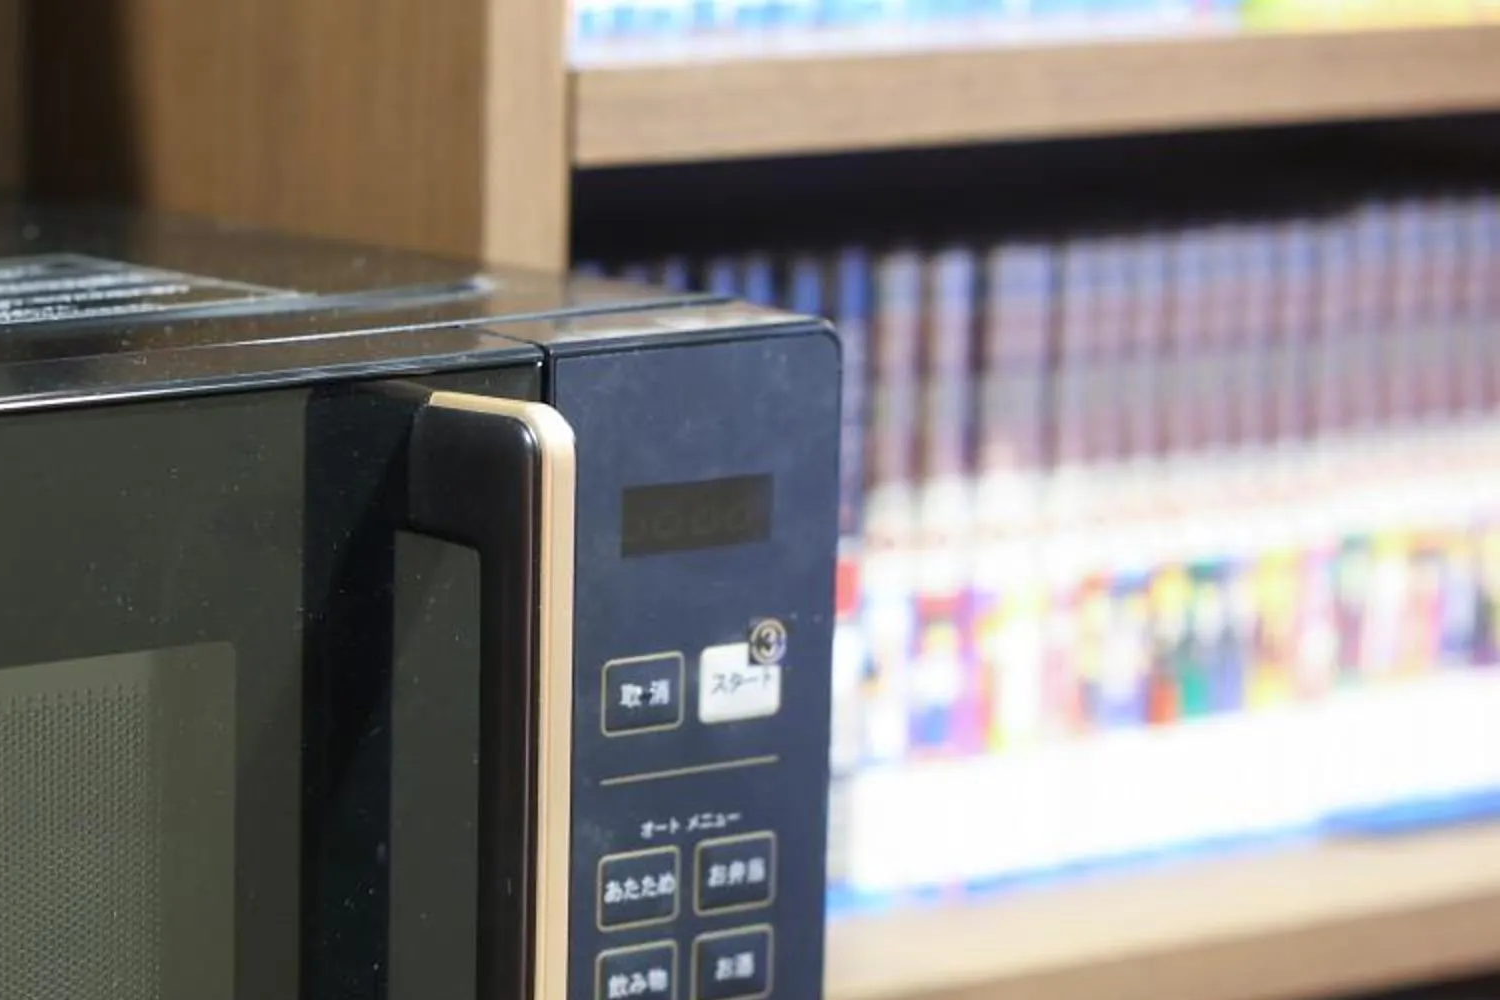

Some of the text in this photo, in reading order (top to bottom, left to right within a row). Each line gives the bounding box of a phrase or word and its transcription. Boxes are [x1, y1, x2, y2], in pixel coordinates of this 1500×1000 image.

[710, 671, 773, 696] スタート
[640, 812, 741, 838] オート メニュー
[604, 872, 676, 904] あたため
